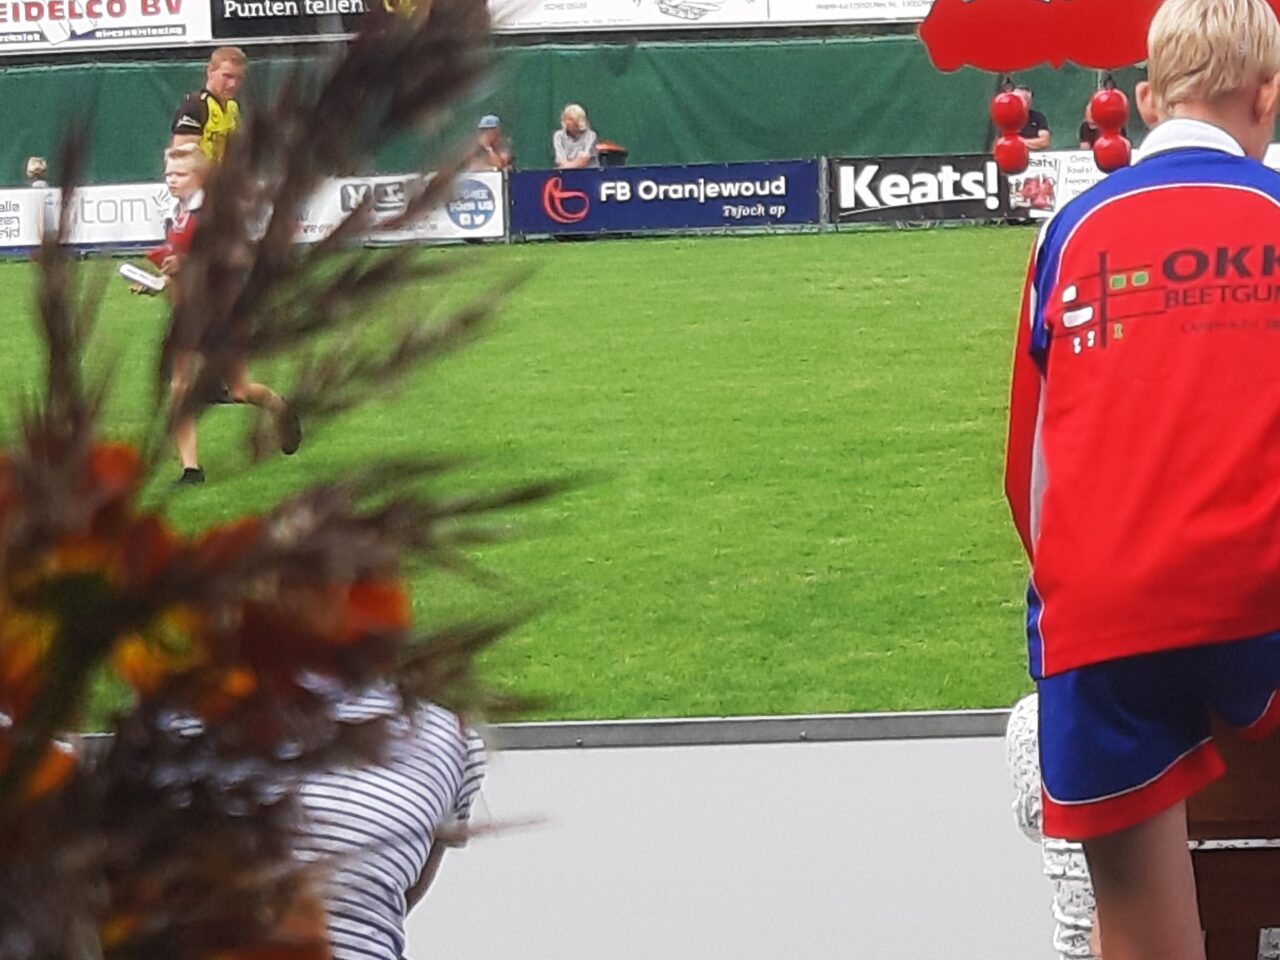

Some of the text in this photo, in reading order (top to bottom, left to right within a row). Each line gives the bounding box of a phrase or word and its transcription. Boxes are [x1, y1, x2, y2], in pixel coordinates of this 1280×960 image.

[600, 175, 786, 204] FB Oranjewoud
[839, 160, 1000, 211] Keats!
